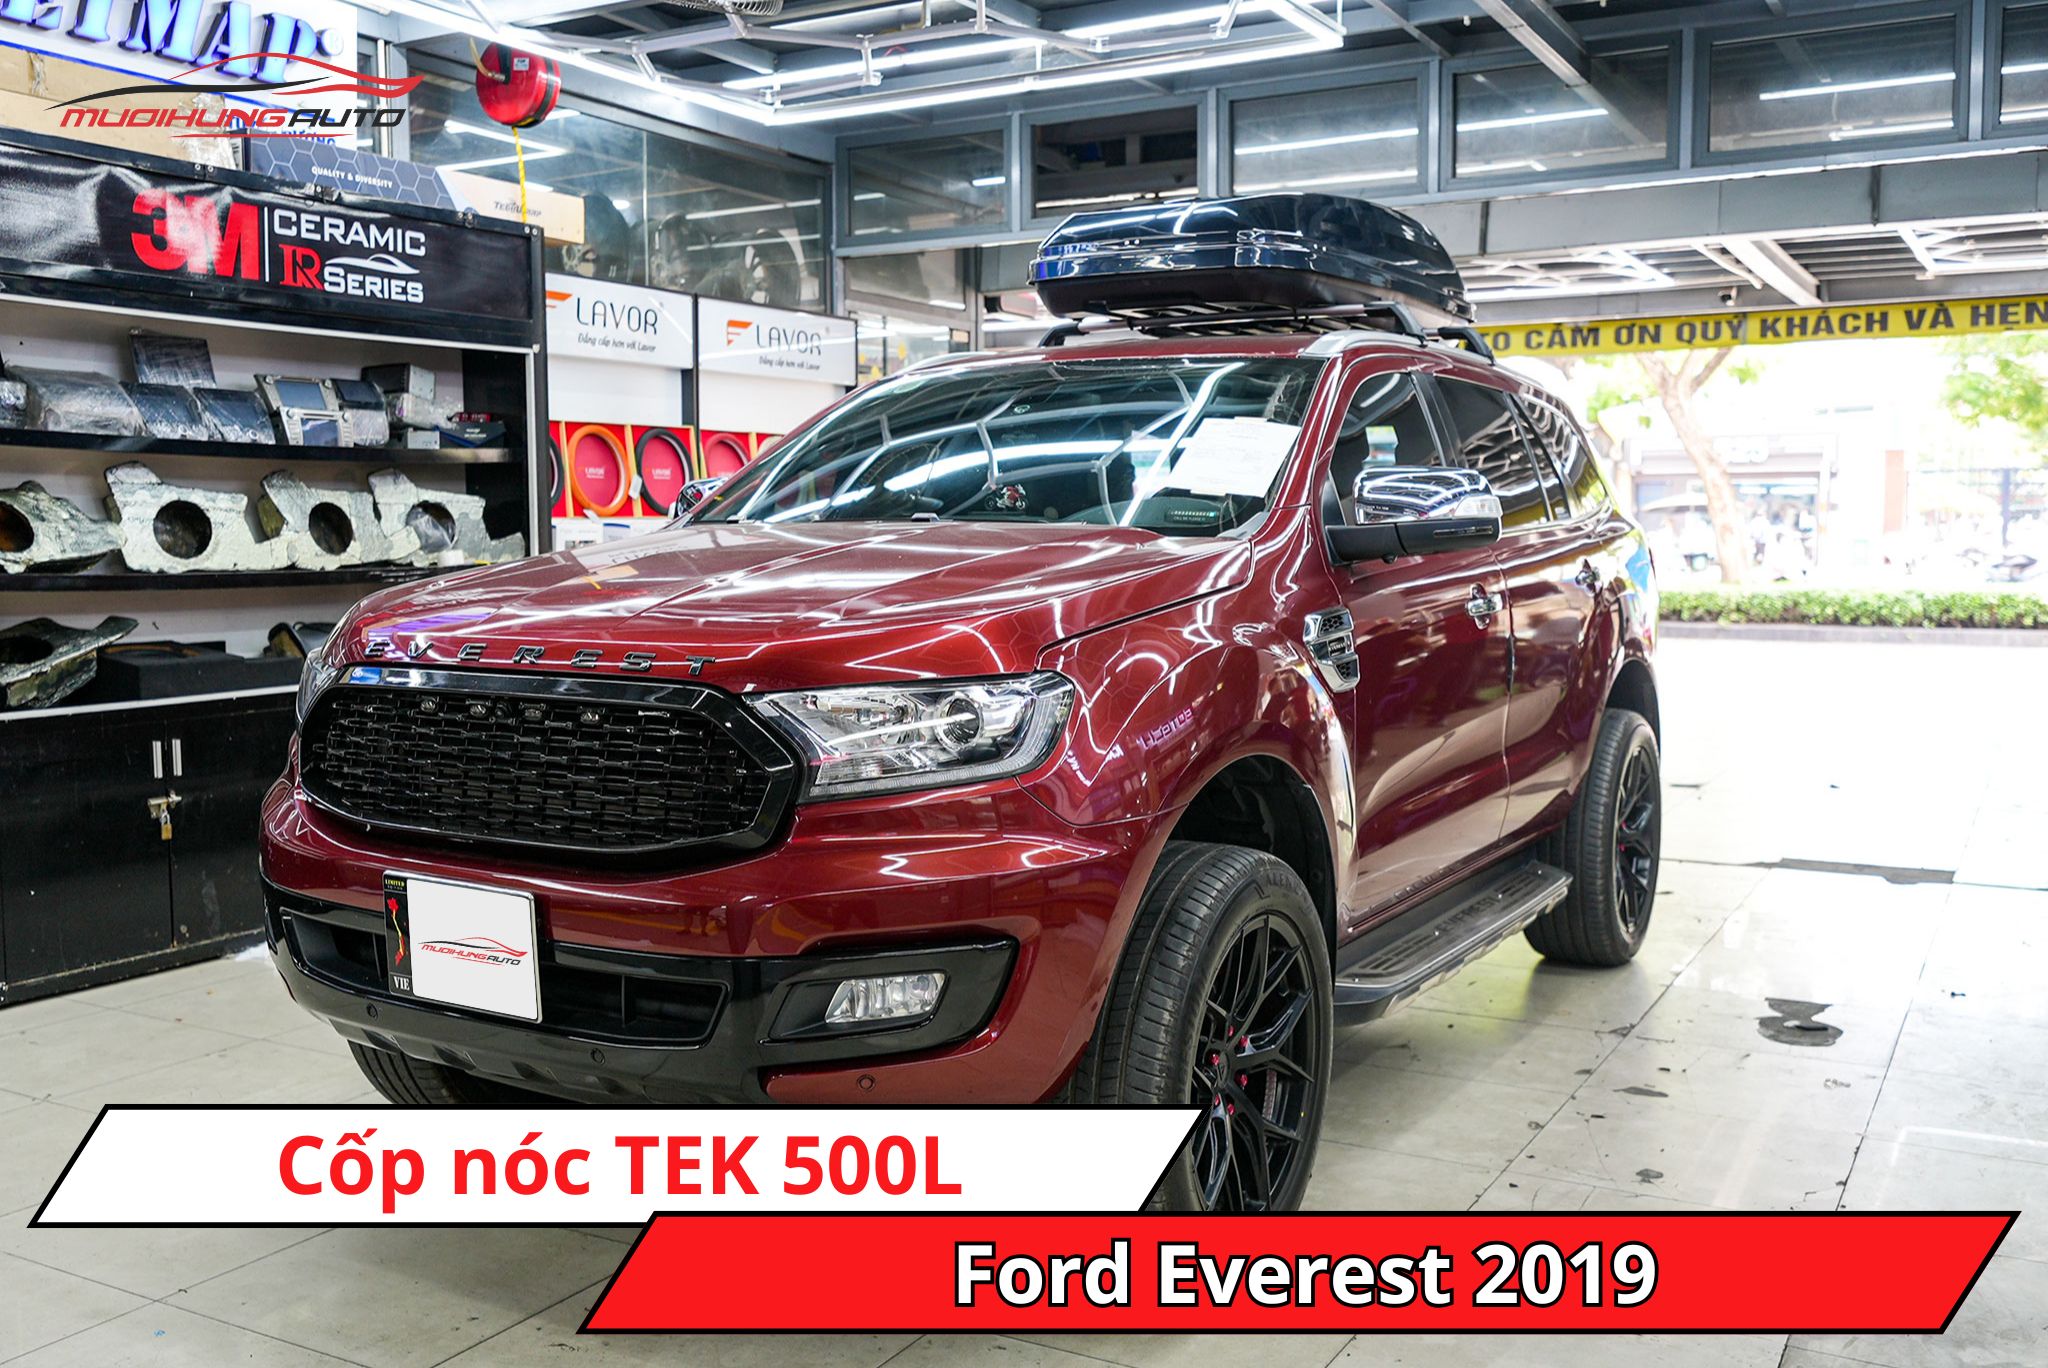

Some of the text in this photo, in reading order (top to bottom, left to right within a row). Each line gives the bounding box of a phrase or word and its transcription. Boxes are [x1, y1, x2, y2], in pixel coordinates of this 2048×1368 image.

[311, 166, 393, 188] QUALITY & DIVERSITY
[131, 188, 260, 281] 3M
[273, 208, 426, 256] CERAMIC
[323, 266, 424, 304] SERIES
[576, 297, 658, 335] LAVOR
[1615, 322, 1662, 346] ƠN
[1676, 315, 1744, 345] QUÝ
[1760, 309, 1889, 339] KHÁCH
[1904, 302, 1954, 331] VÀ
[756, 324, 821, 356] LAVOR
[364, 640, 716, 676] EVEREST
[393, 976, 411, 991] VIE
